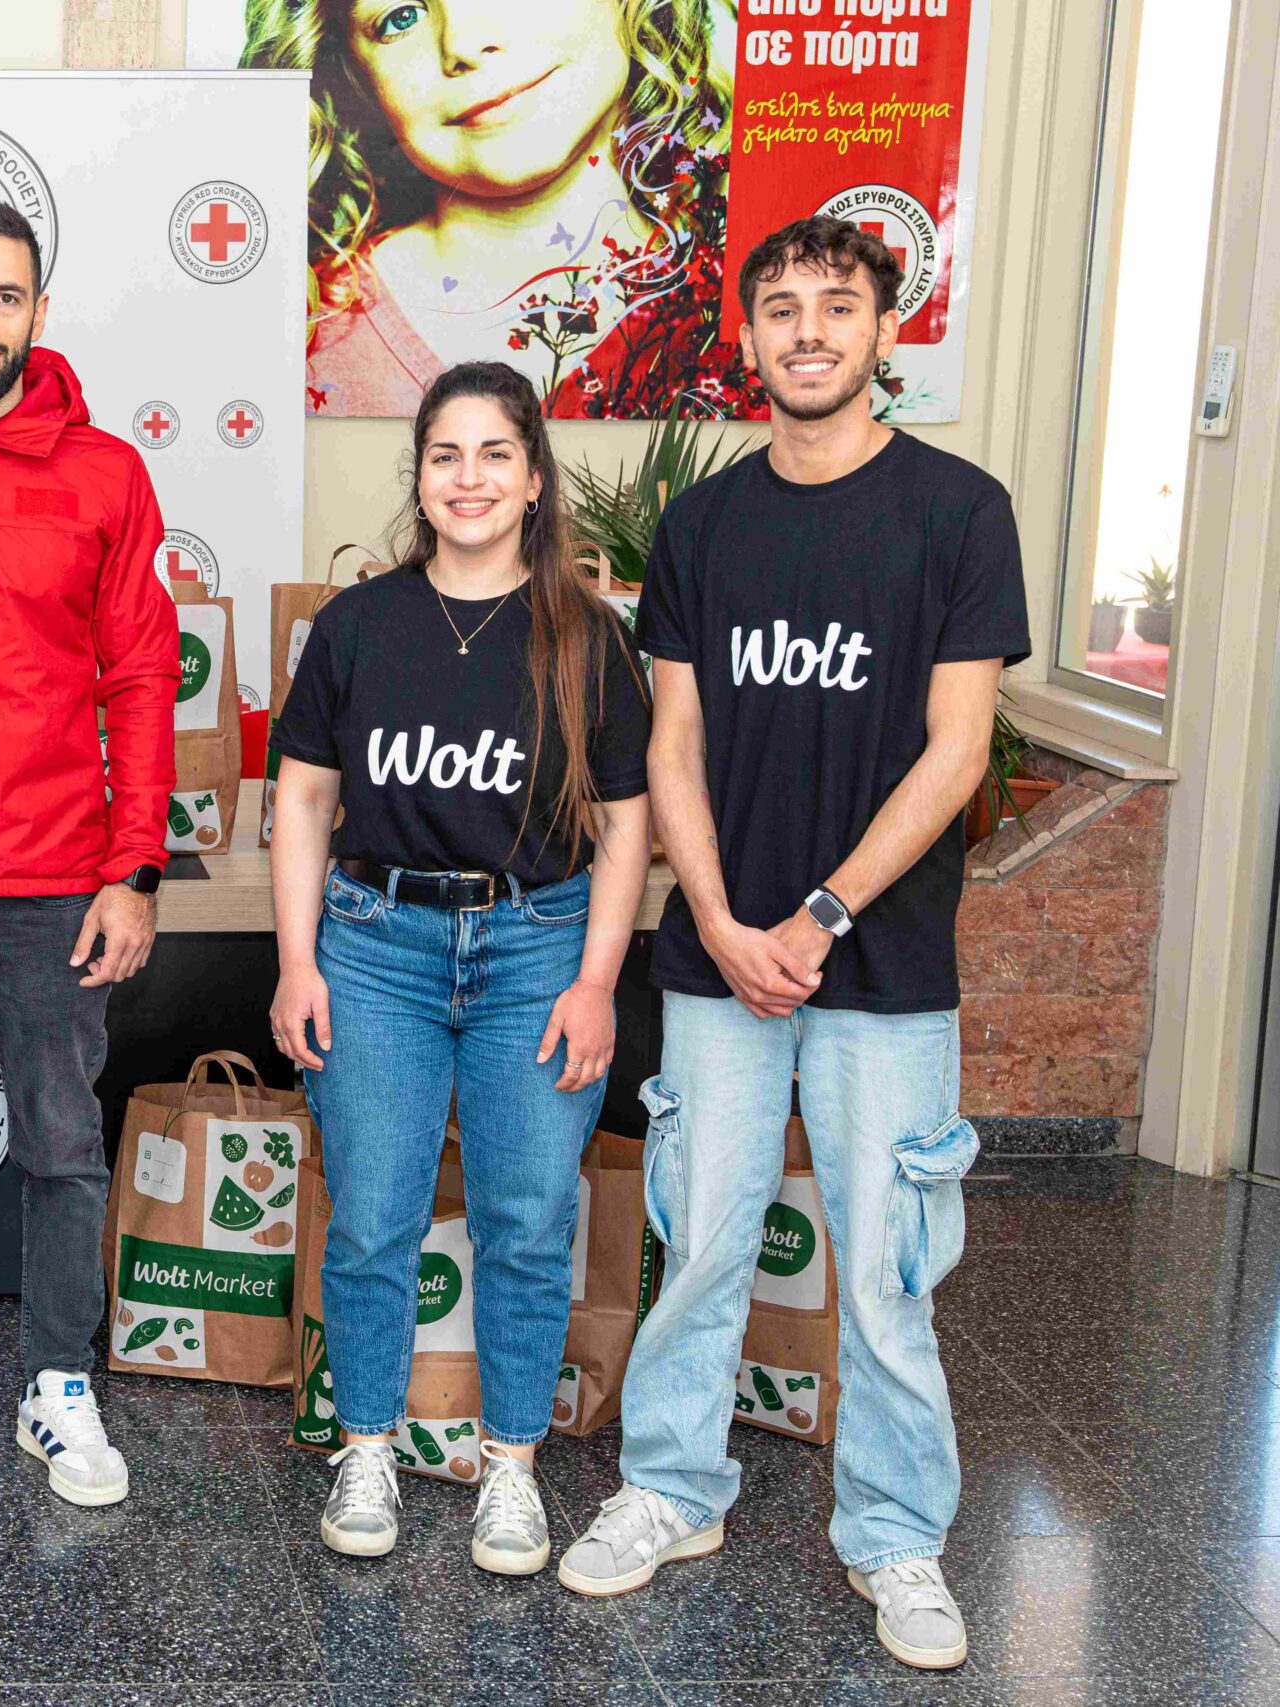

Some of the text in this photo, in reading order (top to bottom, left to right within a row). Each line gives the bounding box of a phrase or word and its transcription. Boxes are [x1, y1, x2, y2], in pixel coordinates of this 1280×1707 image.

[745, 20, 919, 74] σε πόρτα
[827, 91, 864, 118] ένα
[870, 92, 950, 127] μήνυμα
[742, 117, 902, 155] γεμάτο αγάπη!
[175, 187, 262, 229] CYPRUS RED CROSS SOCIETY
[854, 191, 911, 214] ΕΡΥΘΡΟΣ
[907, 208, 935, 261] ΣΤΑΥΡΟΣ
[898, 268, 933, 316] SOCIETY
[165, 535, 192, 546] CROSS
[191, 543, 214, 573] SOCIETY
[731, 619, 872, 691] Wolt
[367, 725, 526, 795] Wolt
[761, 1245, 794, 1261] Market
[134, 1261, 276, 1299] Wolt Market
[417, 1274, 448, 1293] olt
[417, 1295, 442, 1306] arket
